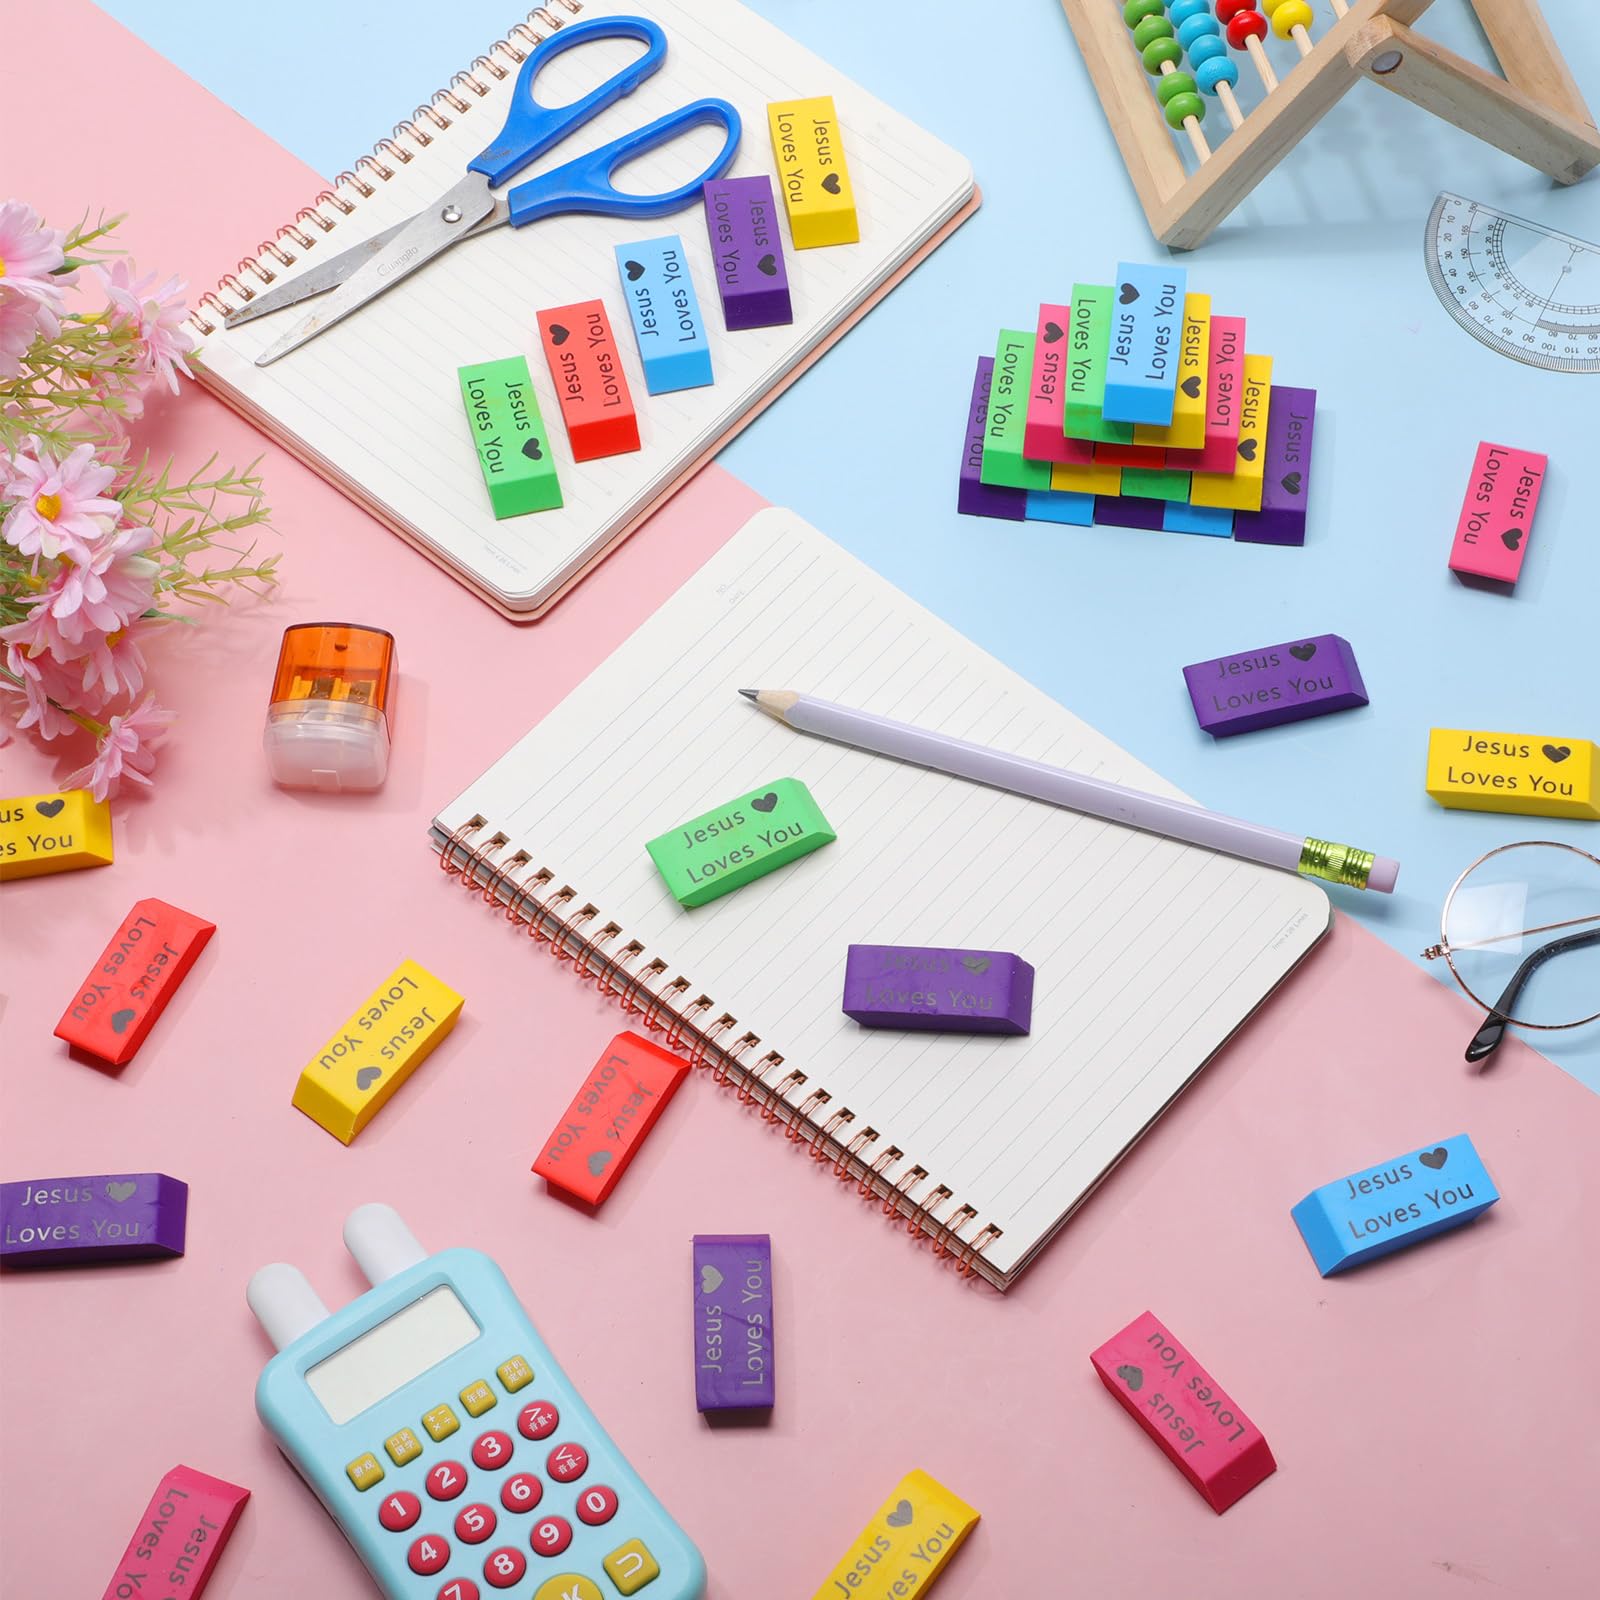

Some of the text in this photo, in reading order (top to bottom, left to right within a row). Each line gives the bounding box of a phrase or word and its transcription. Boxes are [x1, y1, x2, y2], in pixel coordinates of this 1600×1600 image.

[777, 113, 803, 203] Loves You
[813, 118, 833, 166] Jesus
[713, 192, 739, 285] Loves You
[749, 200, 769, 246] Jesus
[1444, 233, 1452, 242] 20
[1447, 215, 1456, 224] 10
[1445, 251, 1453, 260] 30
[1449, 269, 1457, 277] 40
[636, 288, 660, 338] Jesus
[662, 249, 696, 341] Loves You
[1457, 285, 1467, 294] 50
[1468, 301, 1479, 310] 60
[1111, 314, 1135, 365] Jesus
[1145, 284, 1176, 380] Loves You
[1184, 316, 1206, 366] Jesus
[1484, 315, 1494, 324] 70
[1502, 327, 1513, 336] 80
[1522, 334, 1536, 343] 90
[586, 313, 621, 406] Loves You
[1071, 299, 1096, 392] Loves You
[1541, 343, 1556, 351] 100
[561, 352, 584, 402] Jesus
[991, 343, 1025, 438] Loves You
[1035, 353, 1059, 404] Jesus
[1211, 331, 1237, 427] Loves You
[468, 378, 504, 473] Loves You
[505, 381, 530, 430] Jesus
[1243, 378, 1266, 428] Jesus
[1280, 413, 1307, 463] Jesus
[1463, 449, 1508, 545] Loves You
[1510, 466, 1541, 519] Jesus
[1217, 653, 1281, 678] Jesus
[1213, 674, 1334, 713] Loves You
[1462, 735, 1530, 758] Jesus
[1448, 766, 1573, 796] Loves You
[27, 834, 73, 852] You
[684, 810, 745, 849] Jesus
[687, 819, 803, 884] Loves You
[72, 916, 157, 1022] Loves You
[130, 942, 179, 1000] Jesus
[866, 983, 994, 1011] Loves You
[319, 976, 419, 1070] Loves You
[381, 1006, 436, 1060] Jesus
[547, 1054, 629, 1162] Loves You
[606, 1081, 654, 1141] Jesus
[21, 1186, 92, 1206] Jesus
[1347, 1162, 1413, 1199] Jesus
[6, 1219, 140, 1245] Loves You
[1348, 1181, 1474, 1240] Loves You
[701, 1305, 723, 1374] Jesus
[743, 1260, 764, 1385] Loves You
[1147, 1332, 1246, 1442] Loves You
[481, 1436, 501, 1458] 3
[1148, 1392, 1205, 1454] Jesus
[435, 1466, 457, 1489] 2
[510, 1478, 531, 1500] 6
[389, 1497, 407, 1517] 1
[463, 1508, 485, 1532] 5
[586, 1492, 606, 1513] 0
[116, 1489, 189, 1600] Loves Yo
[170, 1513, 219, 1587] Jesus
[419, 1540, 437, 1562] 4
[539, 1523, 560, 1545] 9
[910, 1523, 955, 1564] You
[493, 1553, 514, 1575] 8
[834, 1536, 891, 1600] Jesus
[444, 1583, 462, 1600] 7
